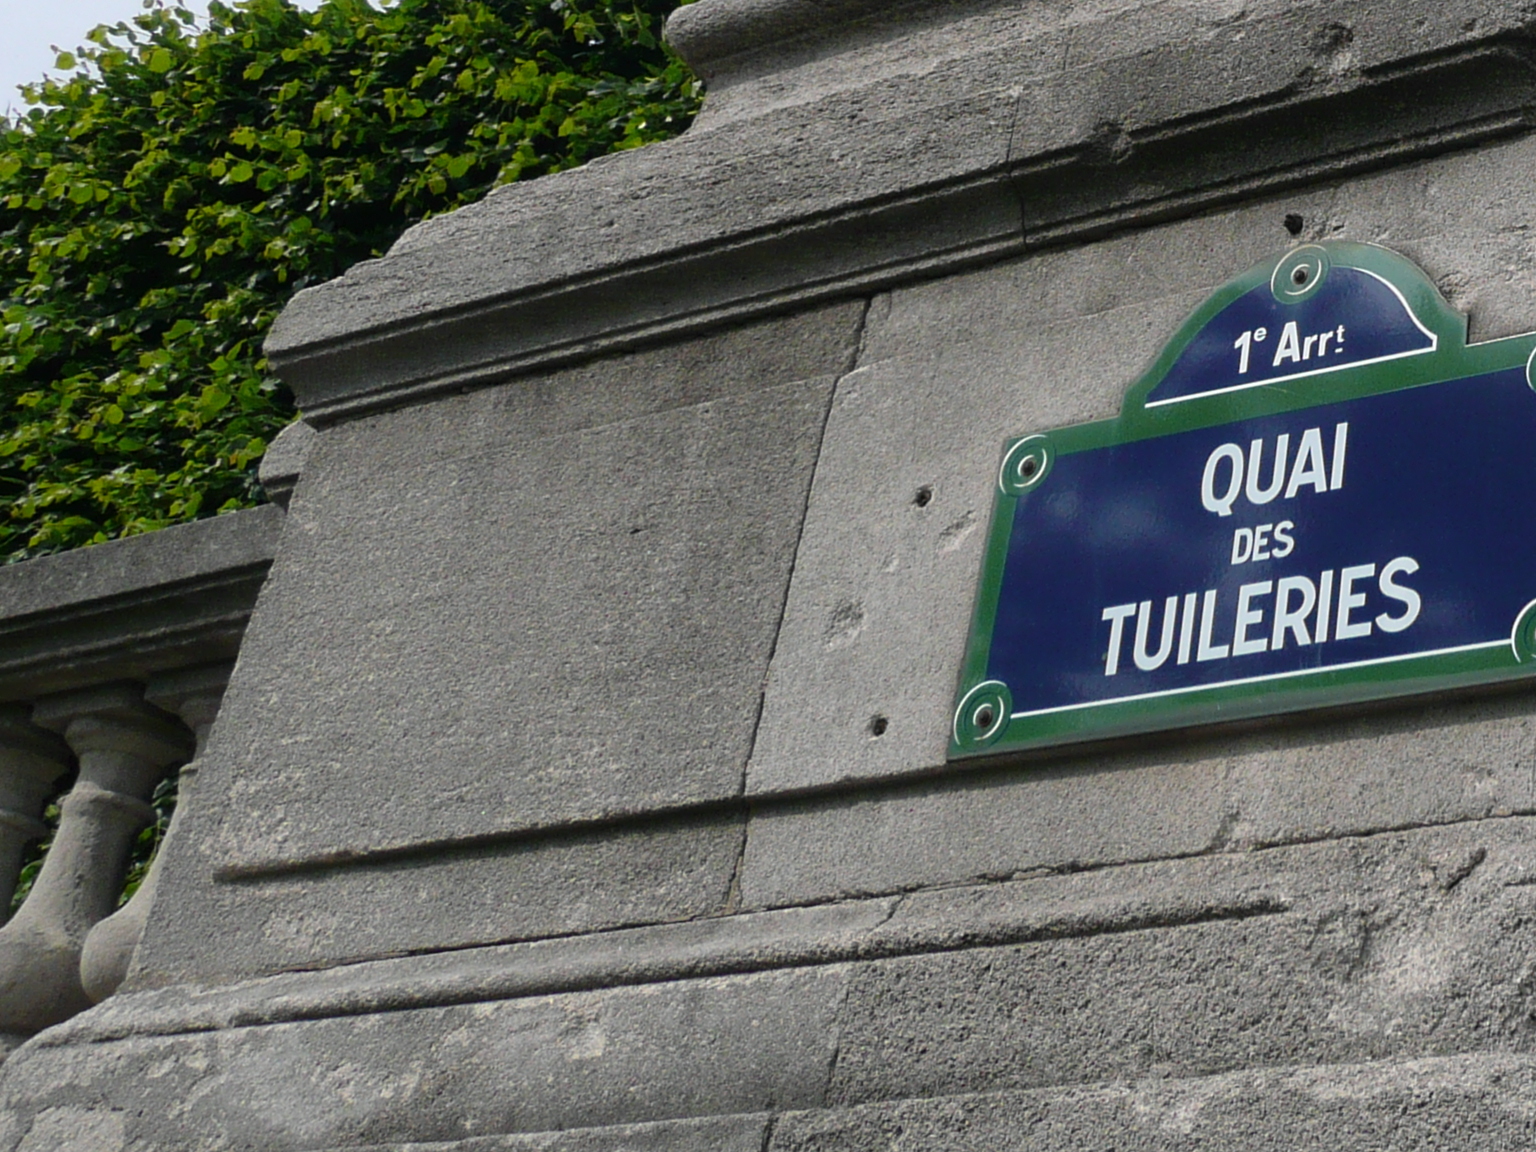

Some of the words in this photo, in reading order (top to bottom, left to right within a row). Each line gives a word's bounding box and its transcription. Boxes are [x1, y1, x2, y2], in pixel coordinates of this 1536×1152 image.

[1201, 422, 1348, 516] QUAI
[1231, 521, 1295, 564] DES
[1102, 556, 1421, 675] TUILERIES
